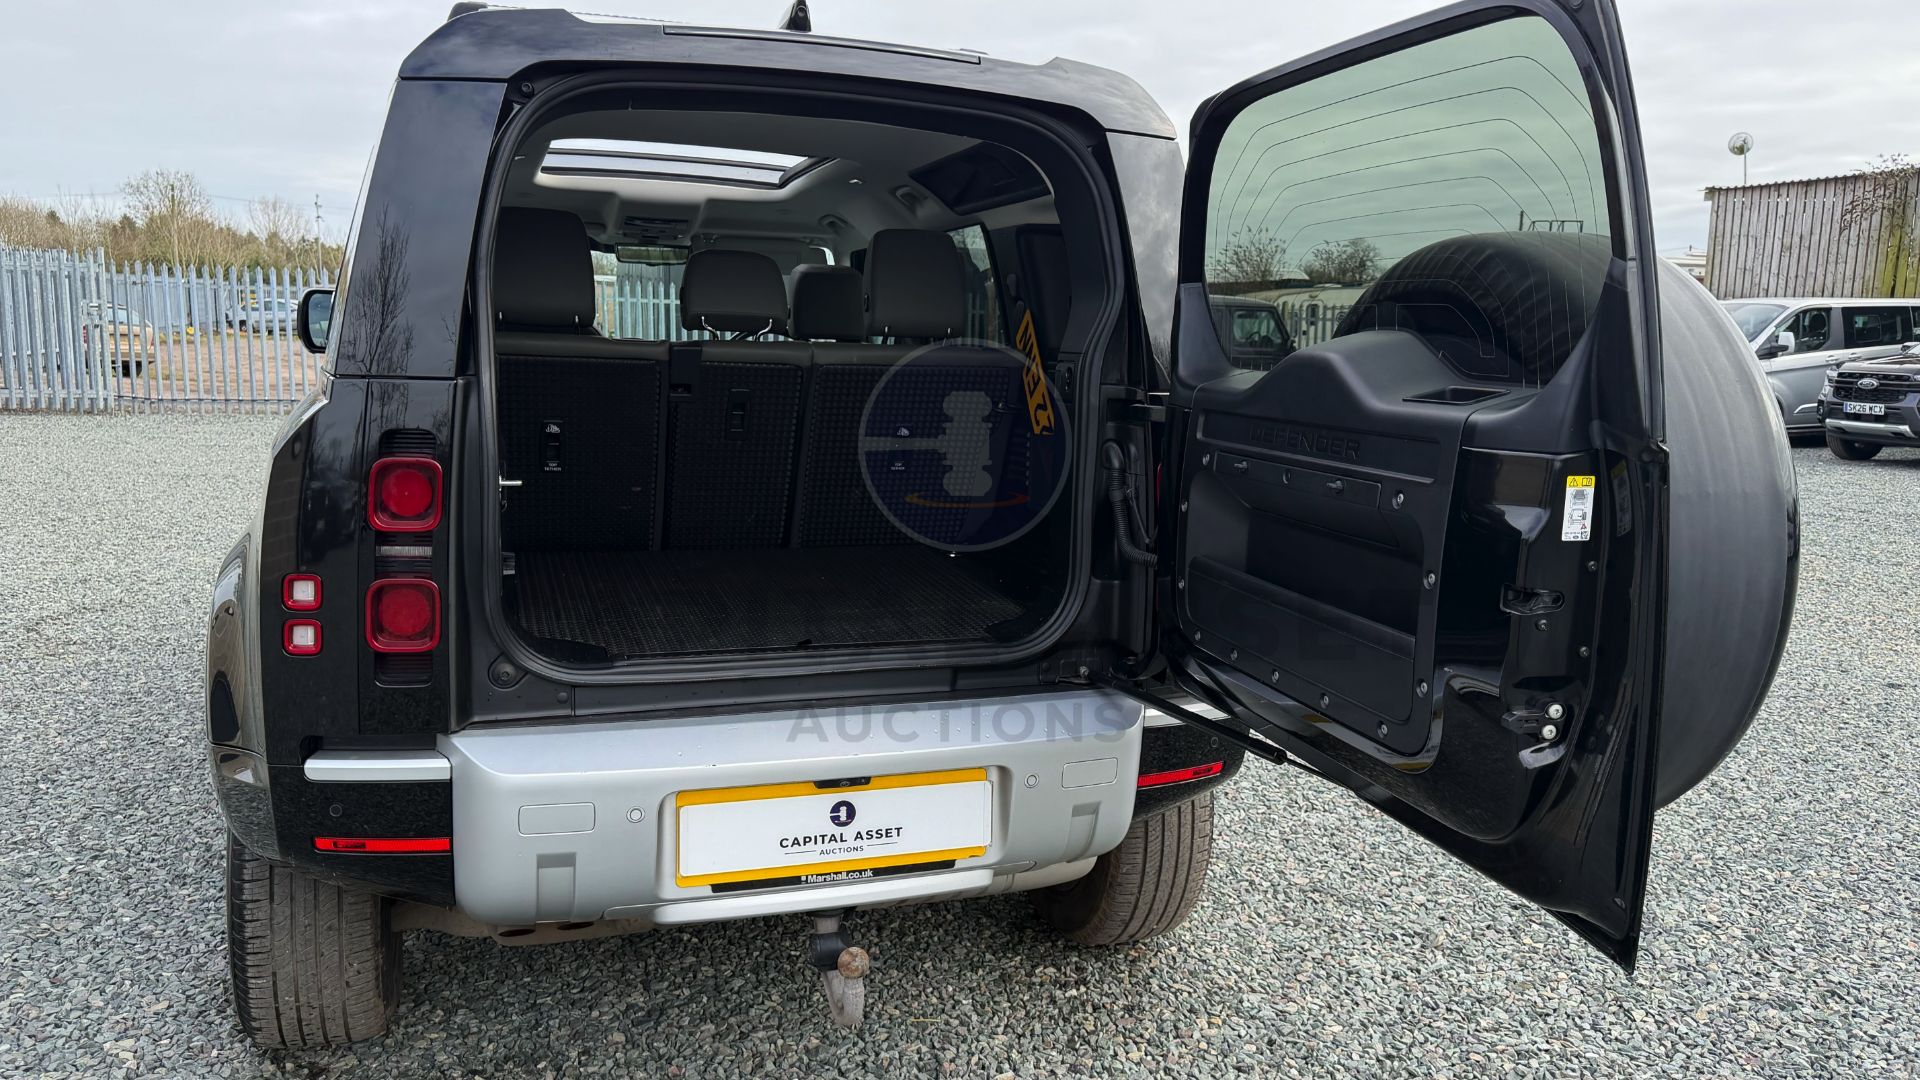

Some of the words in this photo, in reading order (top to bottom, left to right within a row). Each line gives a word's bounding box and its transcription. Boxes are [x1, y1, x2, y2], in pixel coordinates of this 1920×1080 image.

[779, 832, 848, 849] CAPITAL
[853, 826, 903, 842] ASSET
[819, 845, 864, 856] AUCTIONS
[807, 869, 874, 884] Marshall.co.uk
